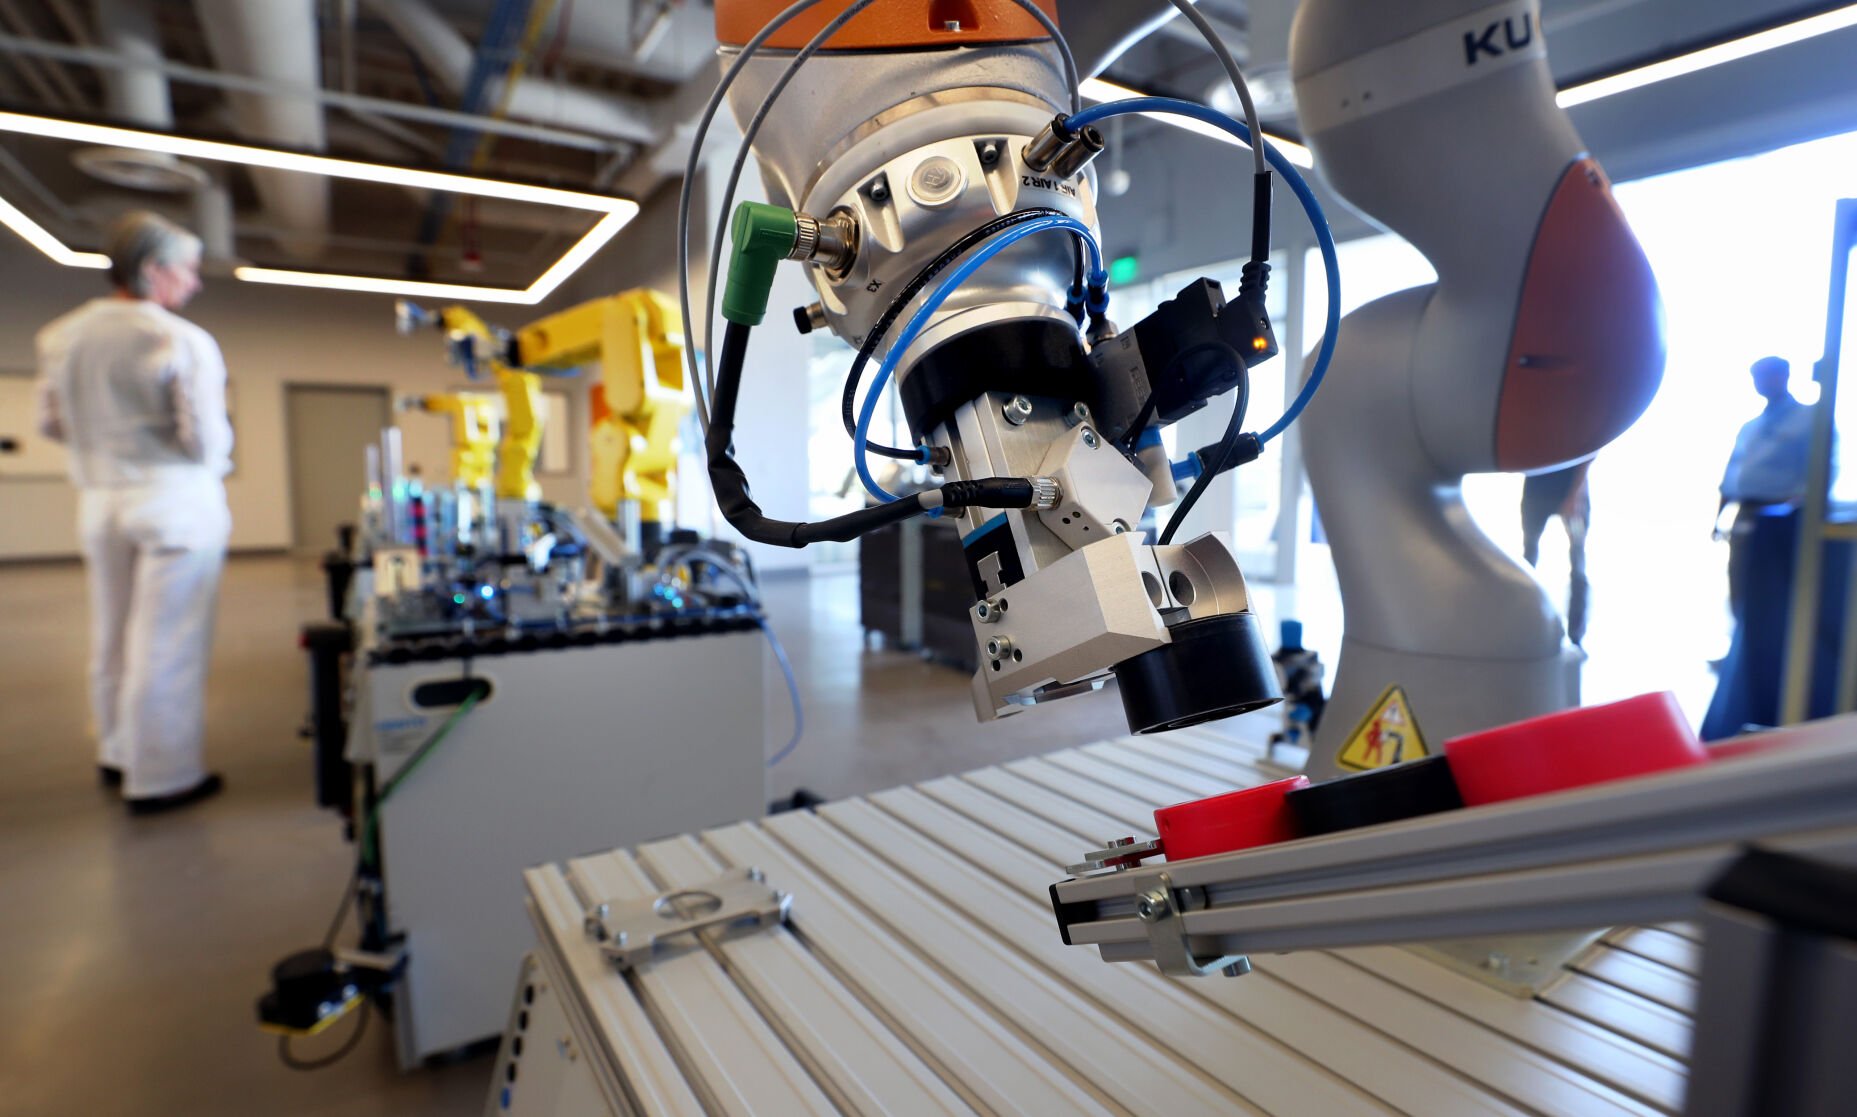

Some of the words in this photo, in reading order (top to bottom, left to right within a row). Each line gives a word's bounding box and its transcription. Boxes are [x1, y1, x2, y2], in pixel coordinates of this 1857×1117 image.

[1021, 175, 1031, 187] 2
[1030, 176, 1052, 190] AIR
[1053, 180, 1059, 191] 1
[866, 279, 882, 293] X3
